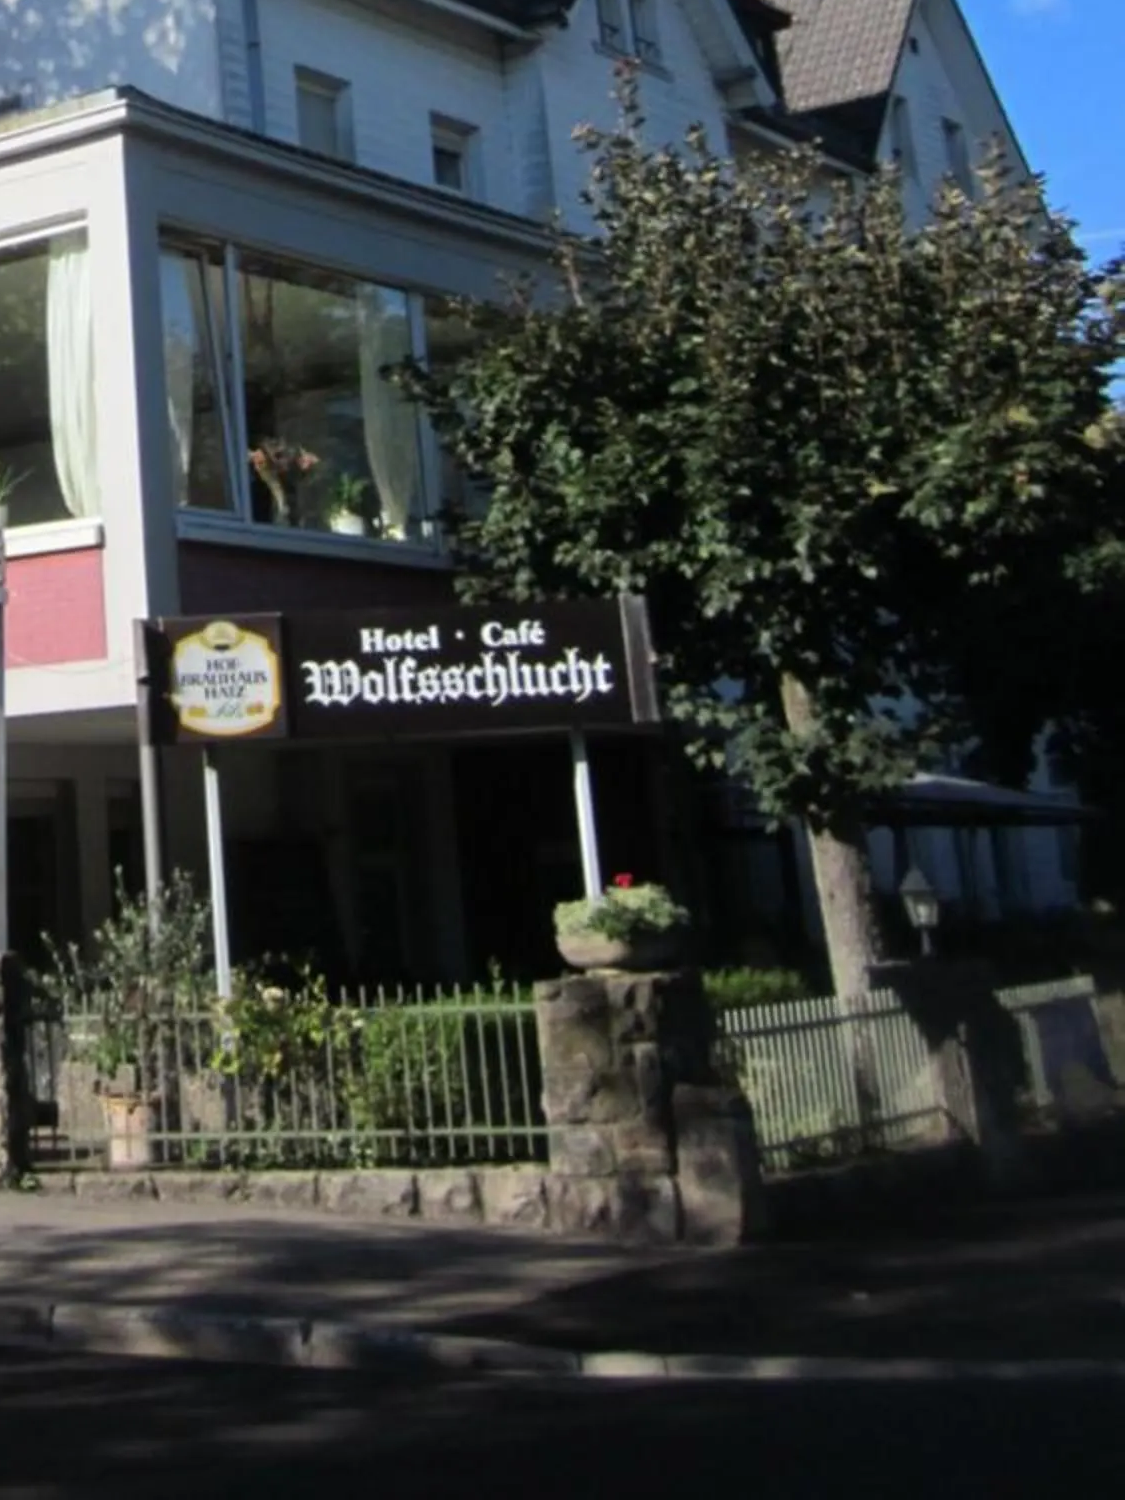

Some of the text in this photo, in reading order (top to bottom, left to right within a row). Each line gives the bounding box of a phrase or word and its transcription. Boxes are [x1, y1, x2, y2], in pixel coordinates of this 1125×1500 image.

[360, 619, 546, 653] Hotel Café
[301, 647, 614, 707] Wolfsschlucht
